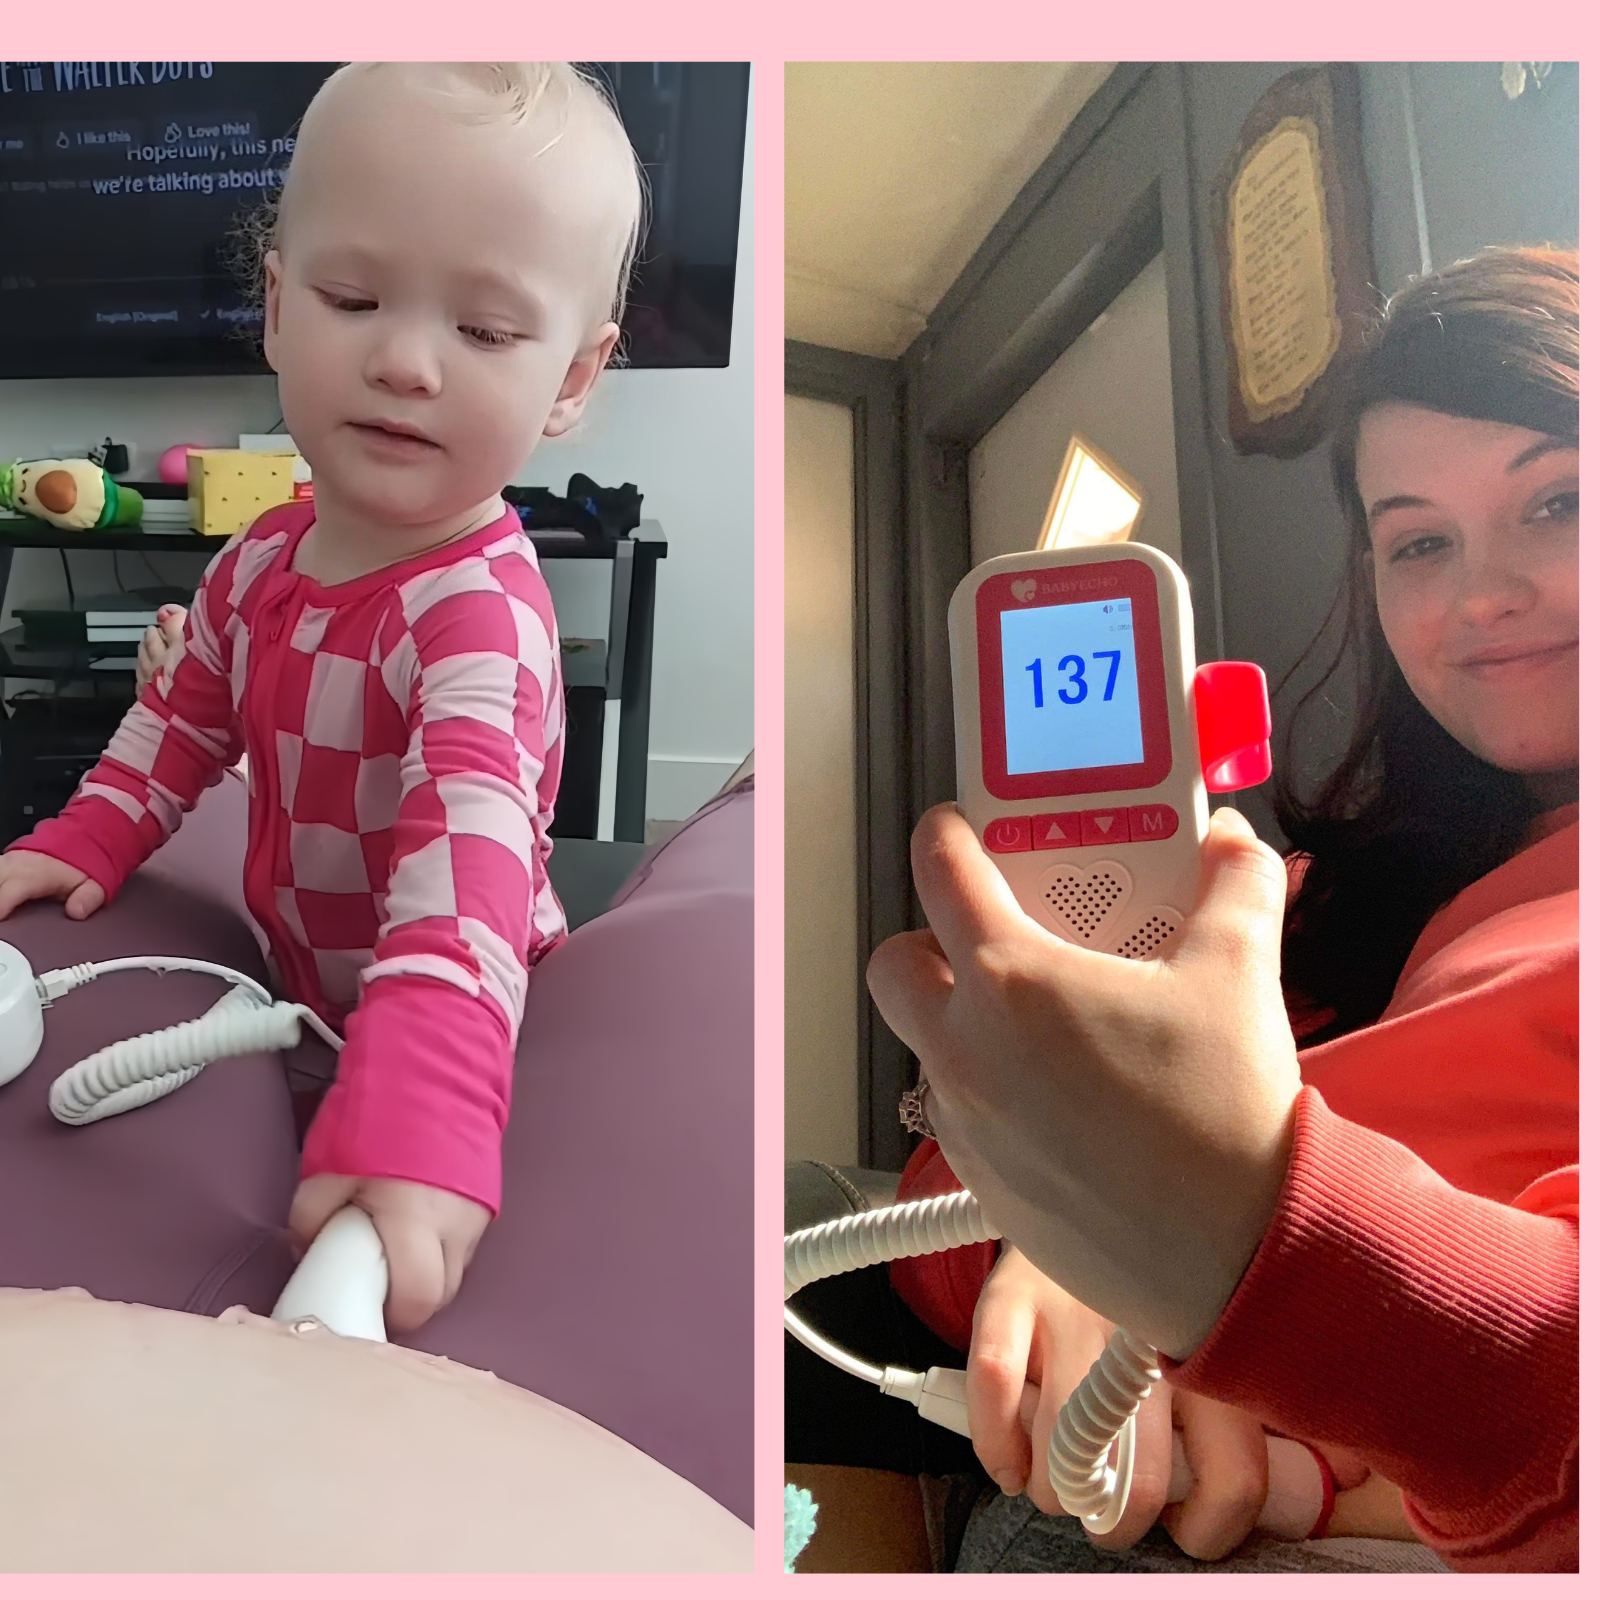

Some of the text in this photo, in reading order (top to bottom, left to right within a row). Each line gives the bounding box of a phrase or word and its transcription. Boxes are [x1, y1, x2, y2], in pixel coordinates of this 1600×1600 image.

[188, 122, 250, 139] Love this!
[126, 141, 226, 164] Hopefully,
[231, 139, 267, 156] this
[91, 175, 144, 195] we're
[148, 171, 214, 195] talking
[218, 168, 276, 188] about
[1041, 577, 1118, 595] BABYECHO
[1025, 650, 1122, 708] 137
[1142, 812, 1164, 831] M
